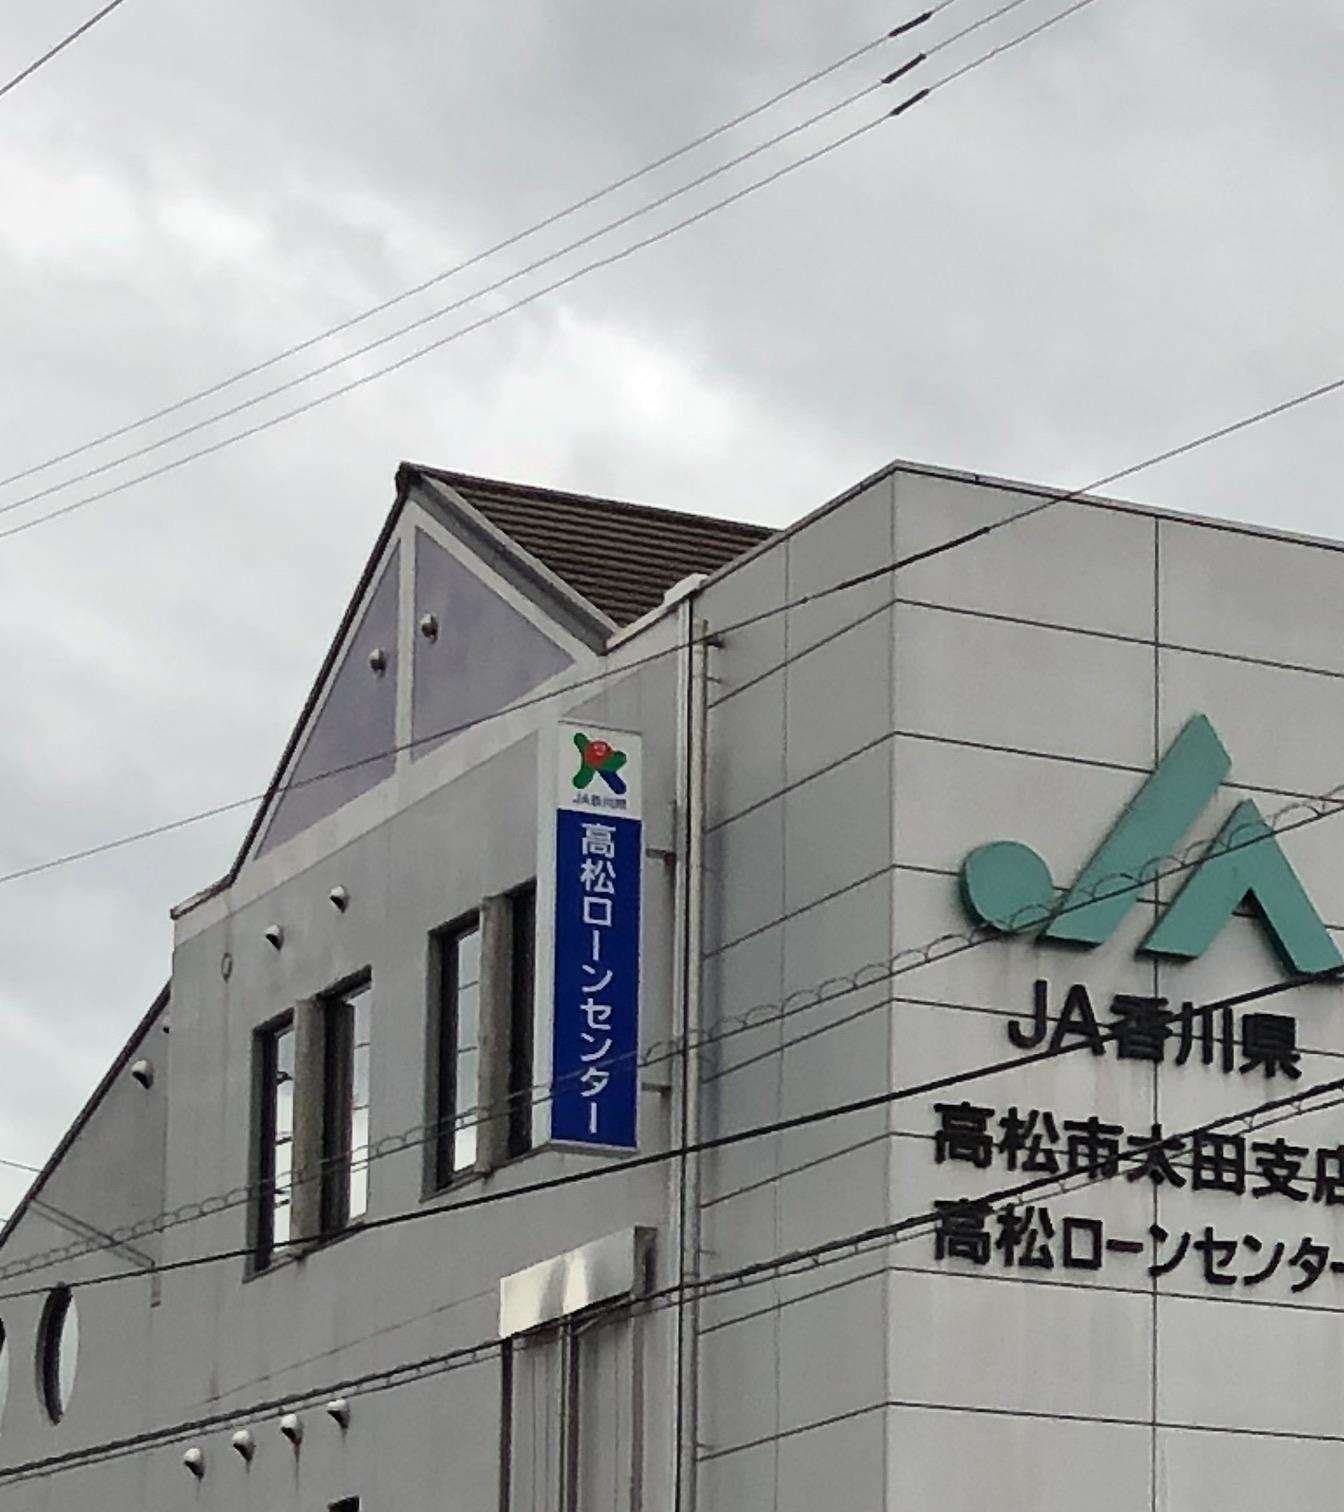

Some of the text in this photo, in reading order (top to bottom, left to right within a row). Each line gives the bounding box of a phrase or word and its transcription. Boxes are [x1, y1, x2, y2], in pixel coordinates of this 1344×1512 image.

[579, 822, 615, 1134] 高松ローンセンター
[1008, 980, 1302, 1080] JA香川県
